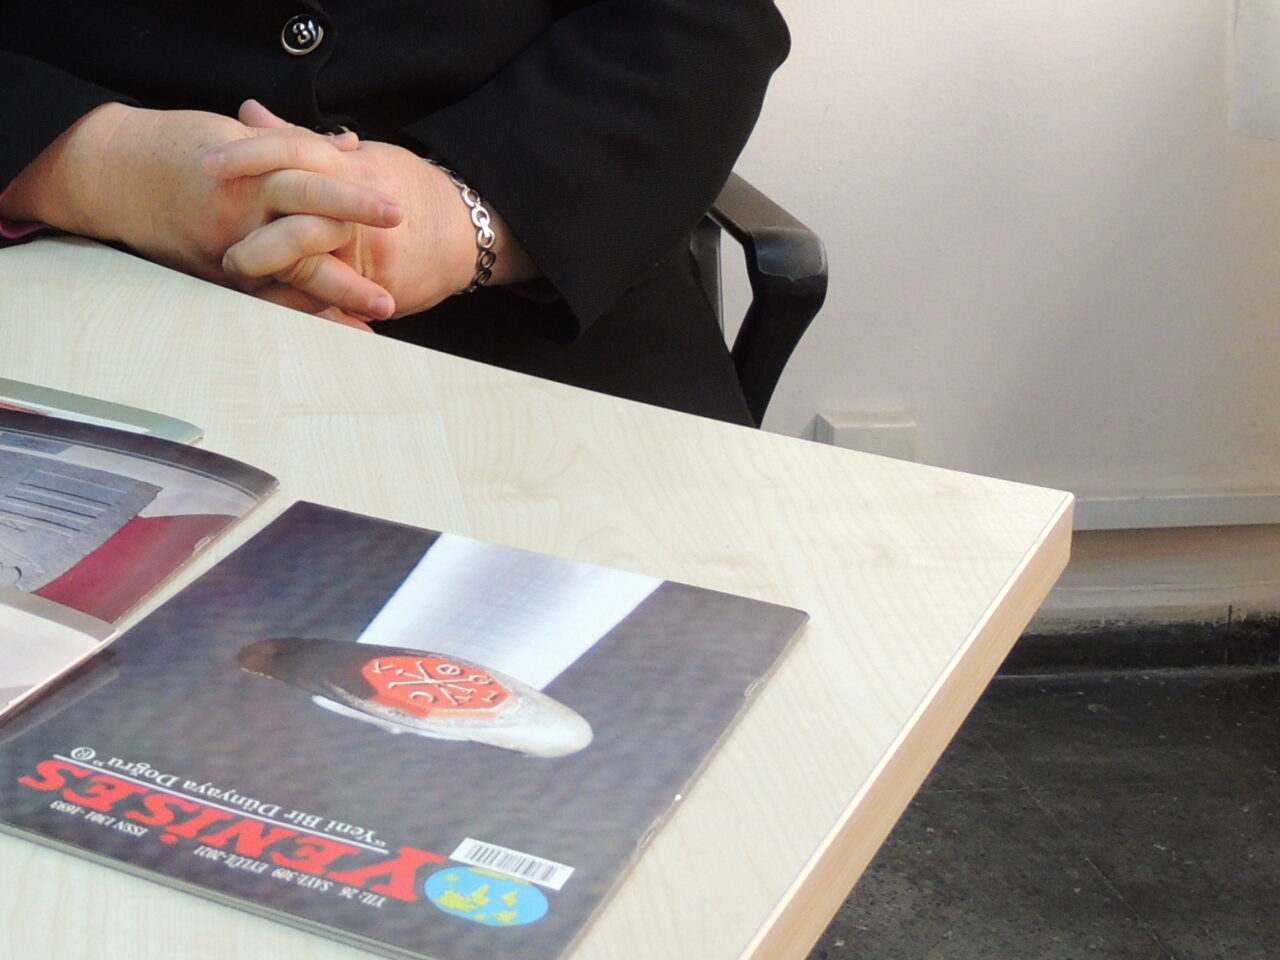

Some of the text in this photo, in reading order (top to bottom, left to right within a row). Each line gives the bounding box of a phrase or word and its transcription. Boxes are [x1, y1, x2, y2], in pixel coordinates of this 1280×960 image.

[182, 780, 282, 816] Dünyaya
[283, 809, 324, 829] Bir
[17, 760, 446, 903] YENİSES
[113, 820, 148, 837] ISSN
[271, 867, 299, 882] 309
[338, 886, 359, 899] 26
